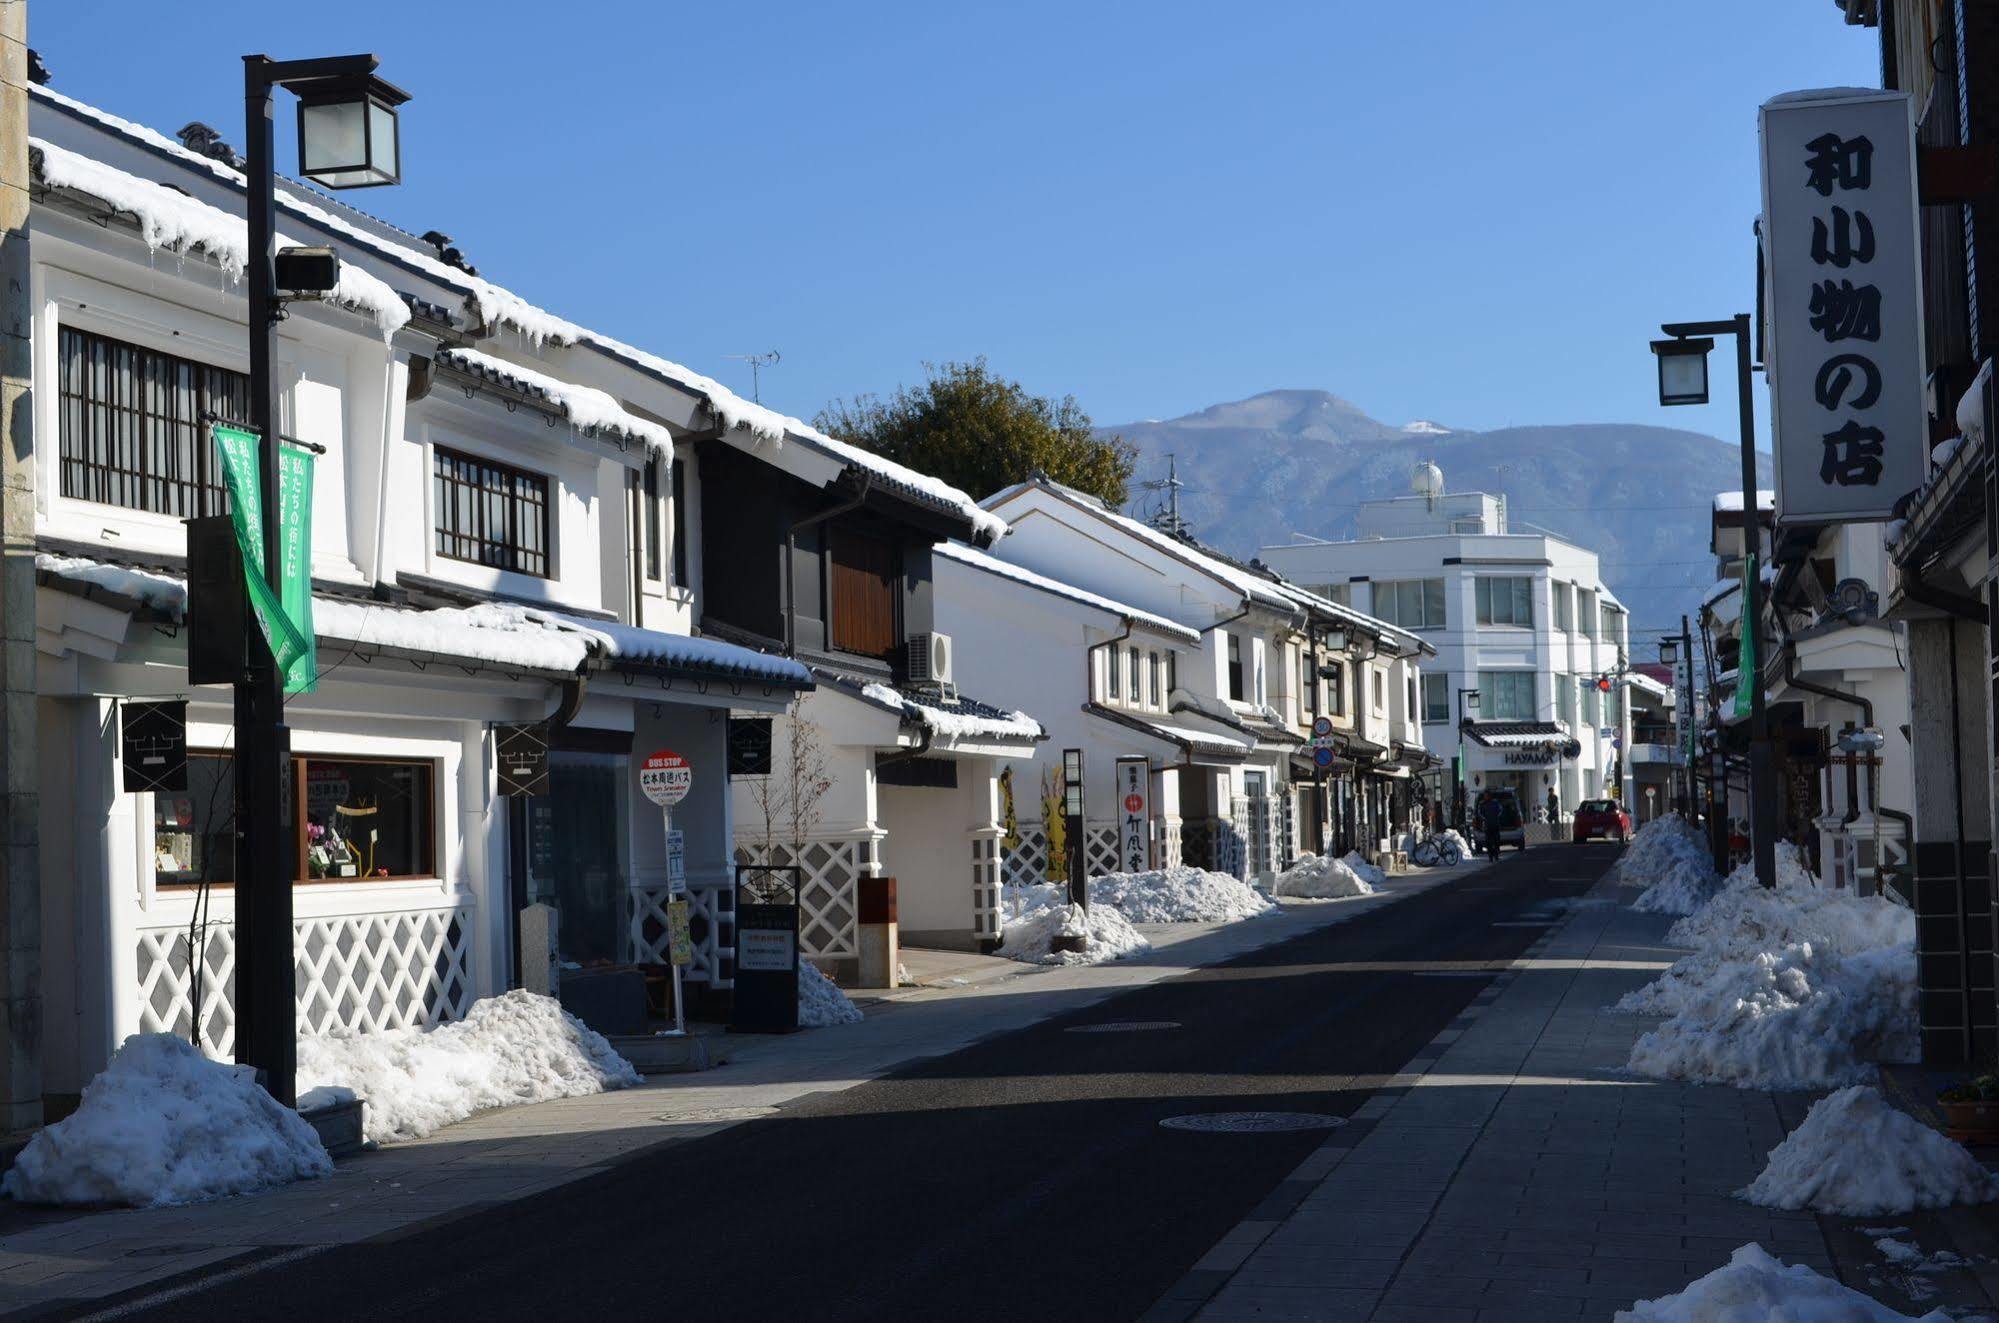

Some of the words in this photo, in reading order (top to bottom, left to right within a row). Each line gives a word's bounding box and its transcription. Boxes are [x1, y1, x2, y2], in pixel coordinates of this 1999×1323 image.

[1804, 132, 1884, 487] 和小物の店
[648, 758, 663, 768] BUS
[664, 757, 682, 767] STOP
